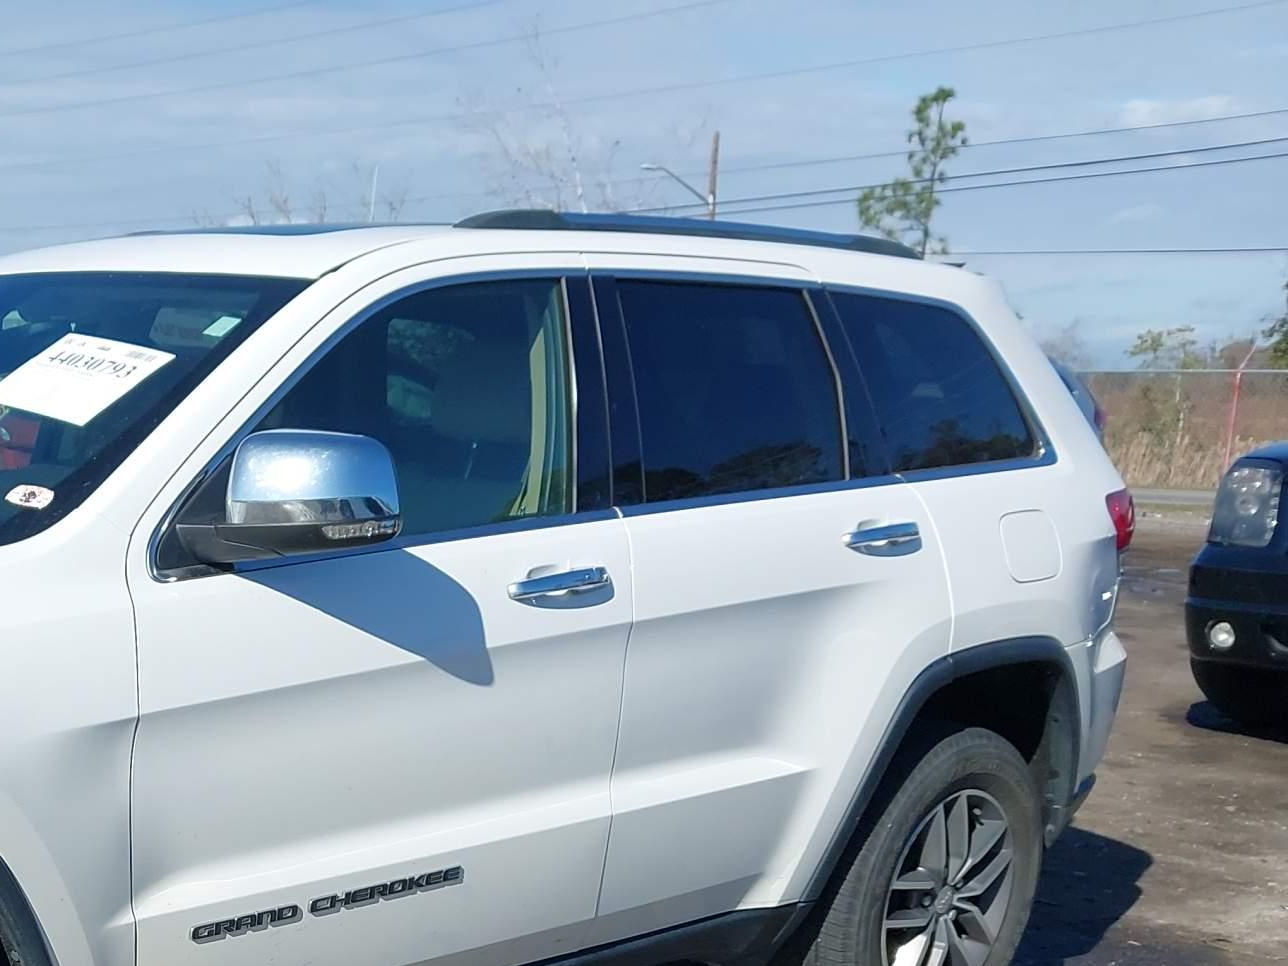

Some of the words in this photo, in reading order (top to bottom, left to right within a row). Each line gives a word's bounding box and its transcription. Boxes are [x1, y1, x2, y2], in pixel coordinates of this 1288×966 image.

[47, 350, 139, 378] 44030793
[190, 904, 302, 943] GRAND
[308, 866, 465, 917] CHEROKEE
